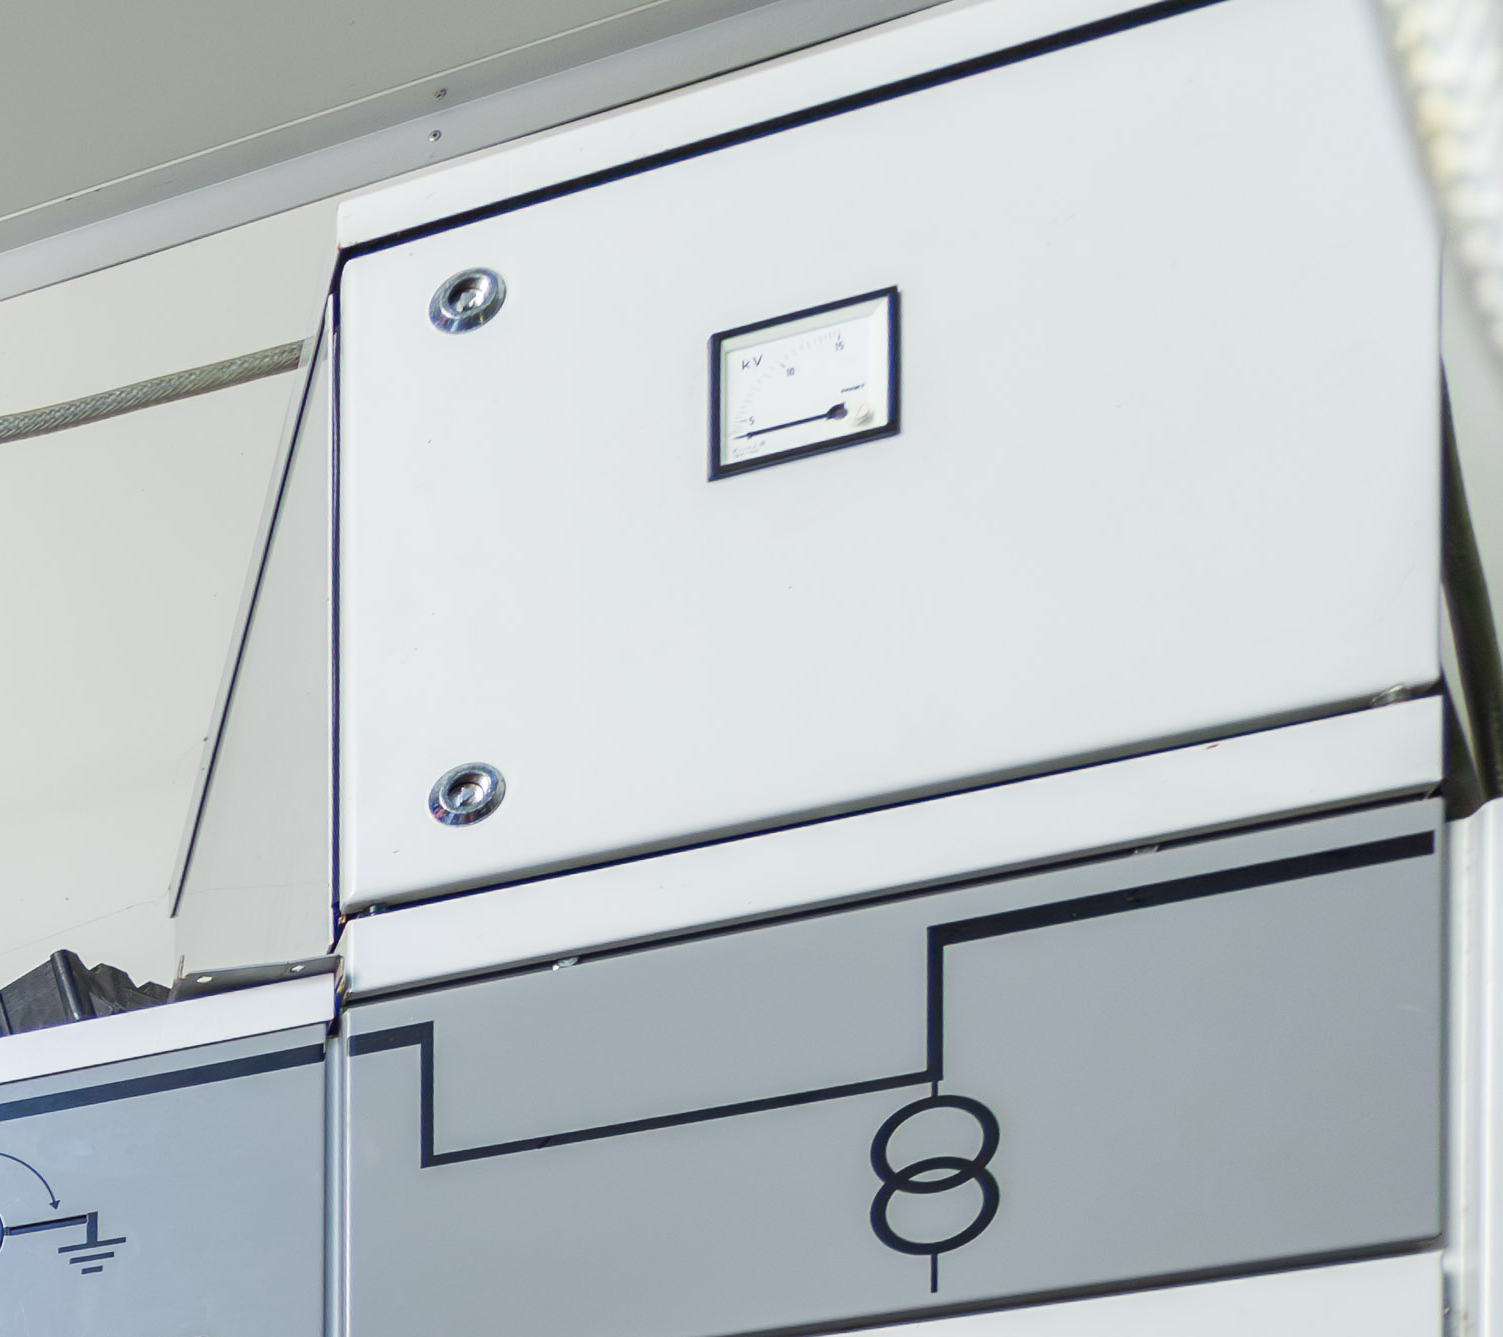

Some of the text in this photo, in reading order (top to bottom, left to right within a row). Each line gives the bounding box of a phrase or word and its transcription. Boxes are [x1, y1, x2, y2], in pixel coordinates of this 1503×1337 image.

[835, 340, 845, 352] 15
[741, 354, 763, 370] kV
[786, 366, 795, 377] 10
[749, 415, 755, 425] 5
